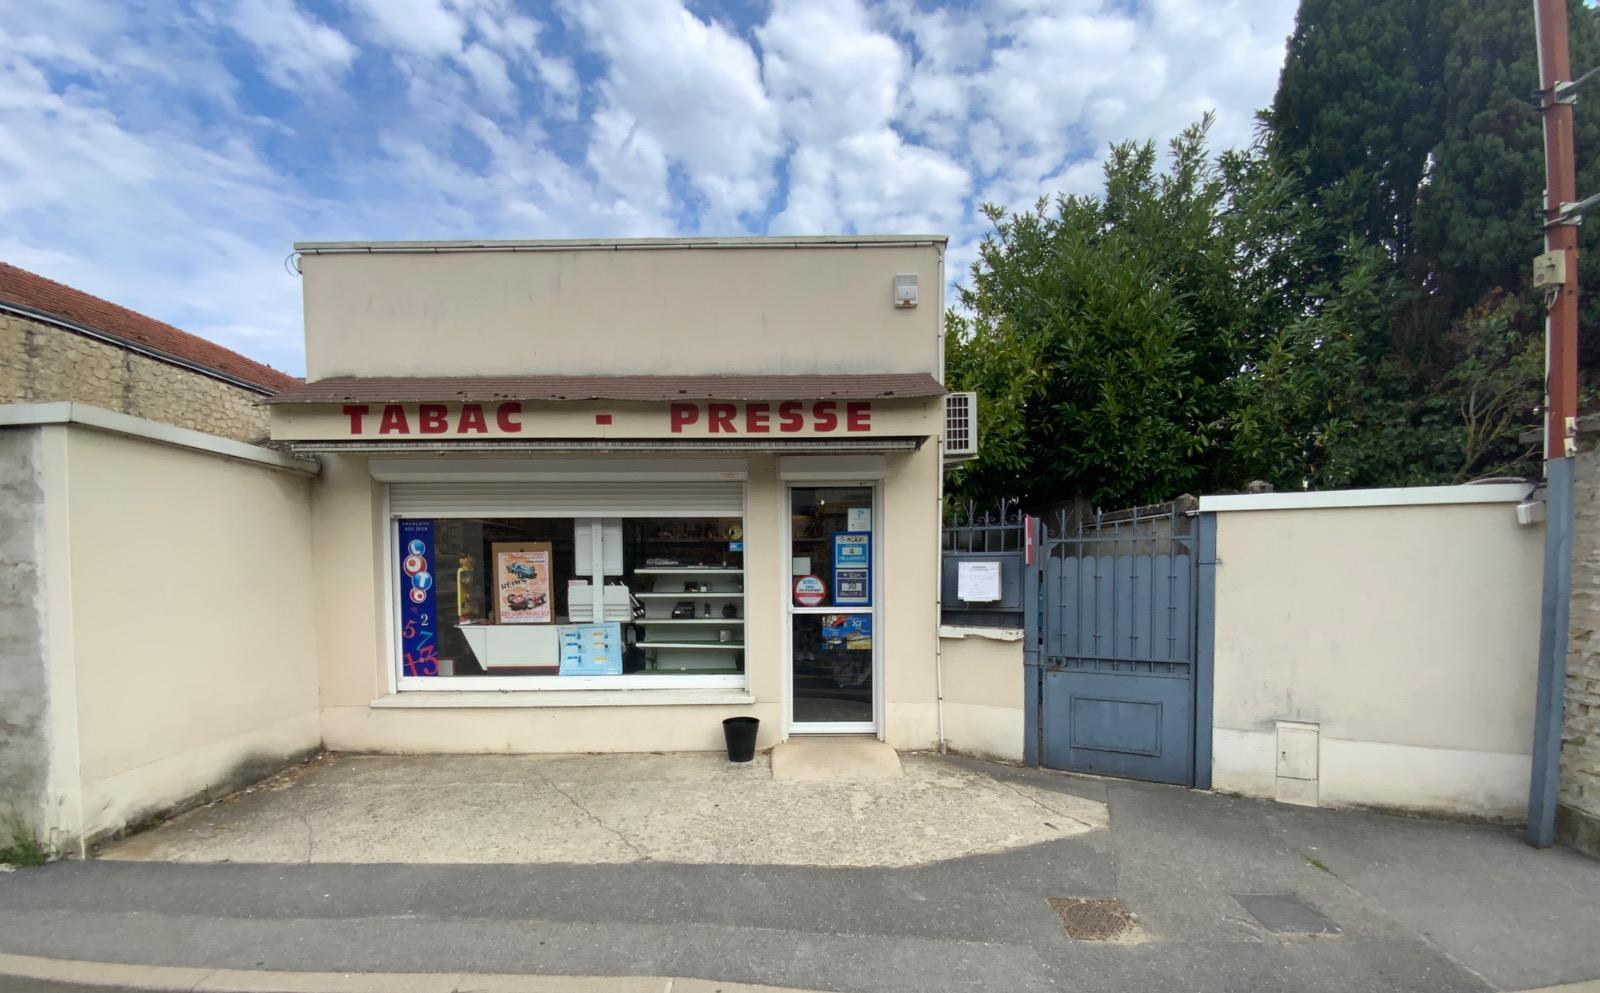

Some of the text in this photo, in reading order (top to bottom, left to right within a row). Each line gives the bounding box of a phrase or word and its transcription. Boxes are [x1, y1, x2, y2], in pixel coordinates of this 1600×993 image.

[343, 402, 522, 434] TABAC
[670, 401, 871, 433] PRESSE
[501, 579, 527, 590] REIMS
[402, 619, 417, 639] 5
[420, 613, 429, 626] 2
[416, 630, 433, 651] 7
